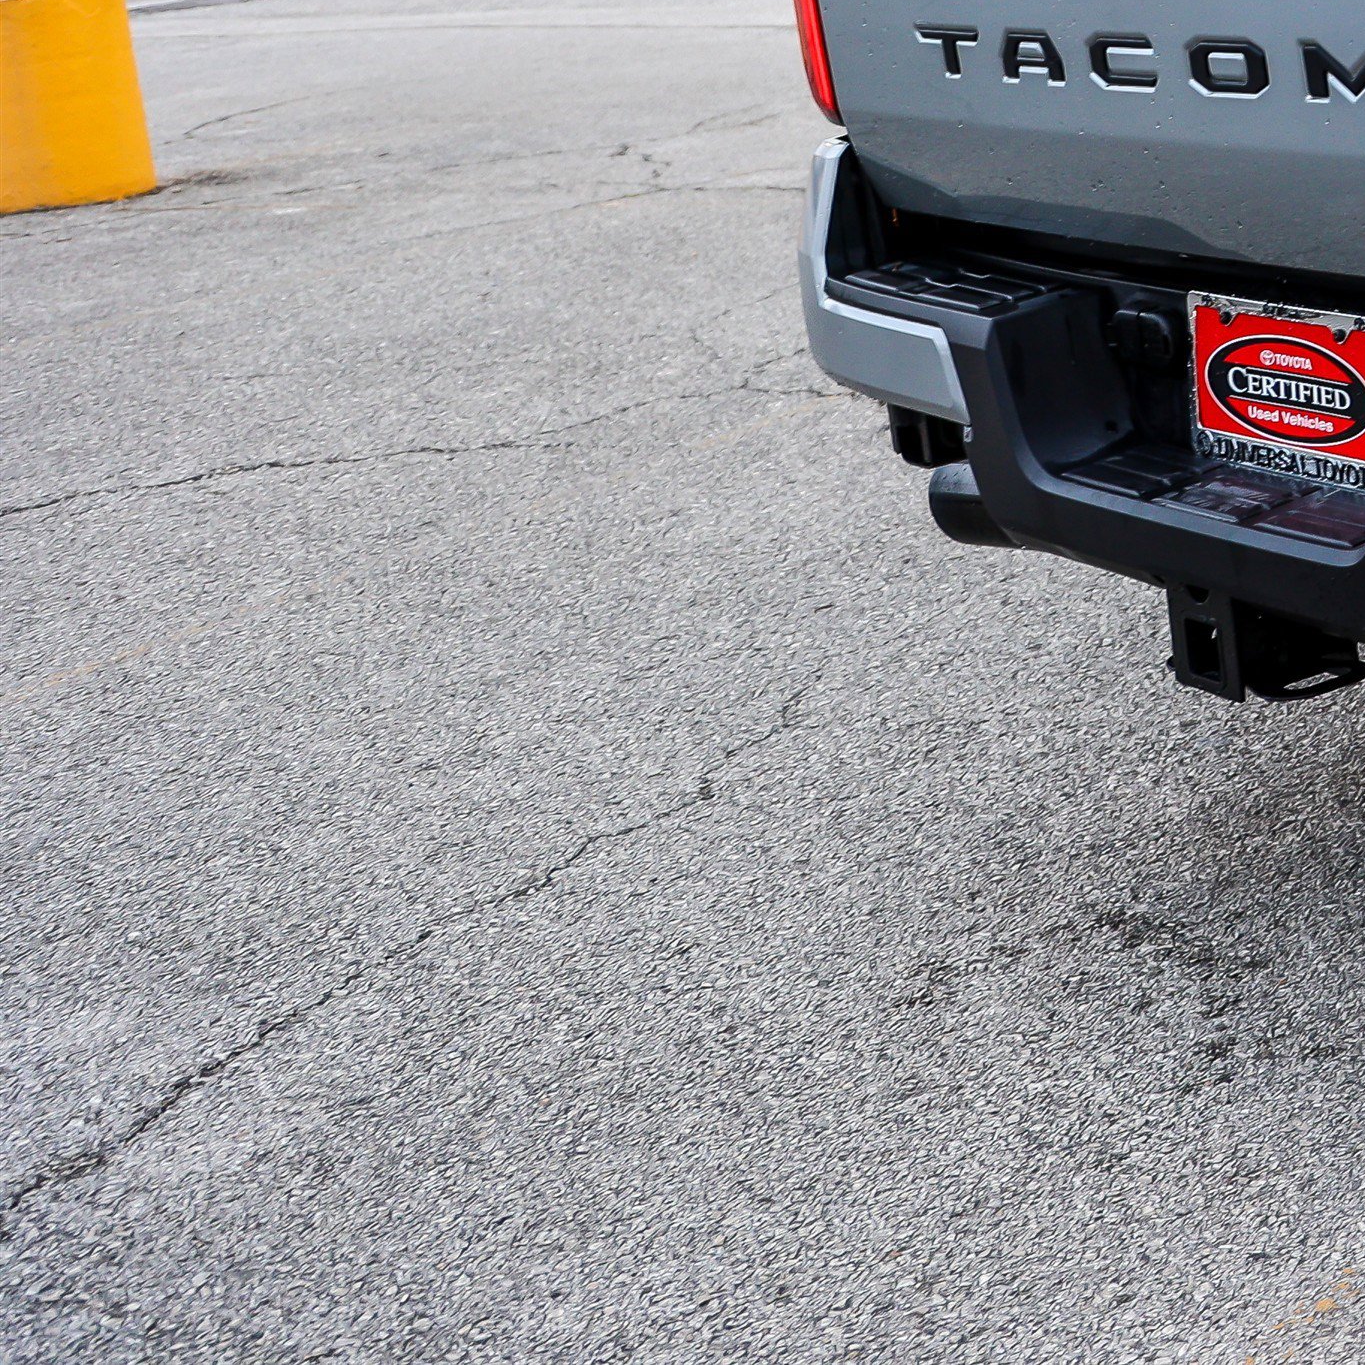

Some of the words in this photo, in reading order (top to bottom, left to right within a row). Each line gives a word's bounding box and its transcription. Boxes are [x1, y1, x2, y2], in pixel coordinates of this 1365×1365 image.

[1274, 353, 1313, 371] TOYOTA
[1227, 366, 1351, 410] CERTIFIED
[1247, 405, 1280, 423] Used
[1281, 410, 1334, 433] Vehicles
